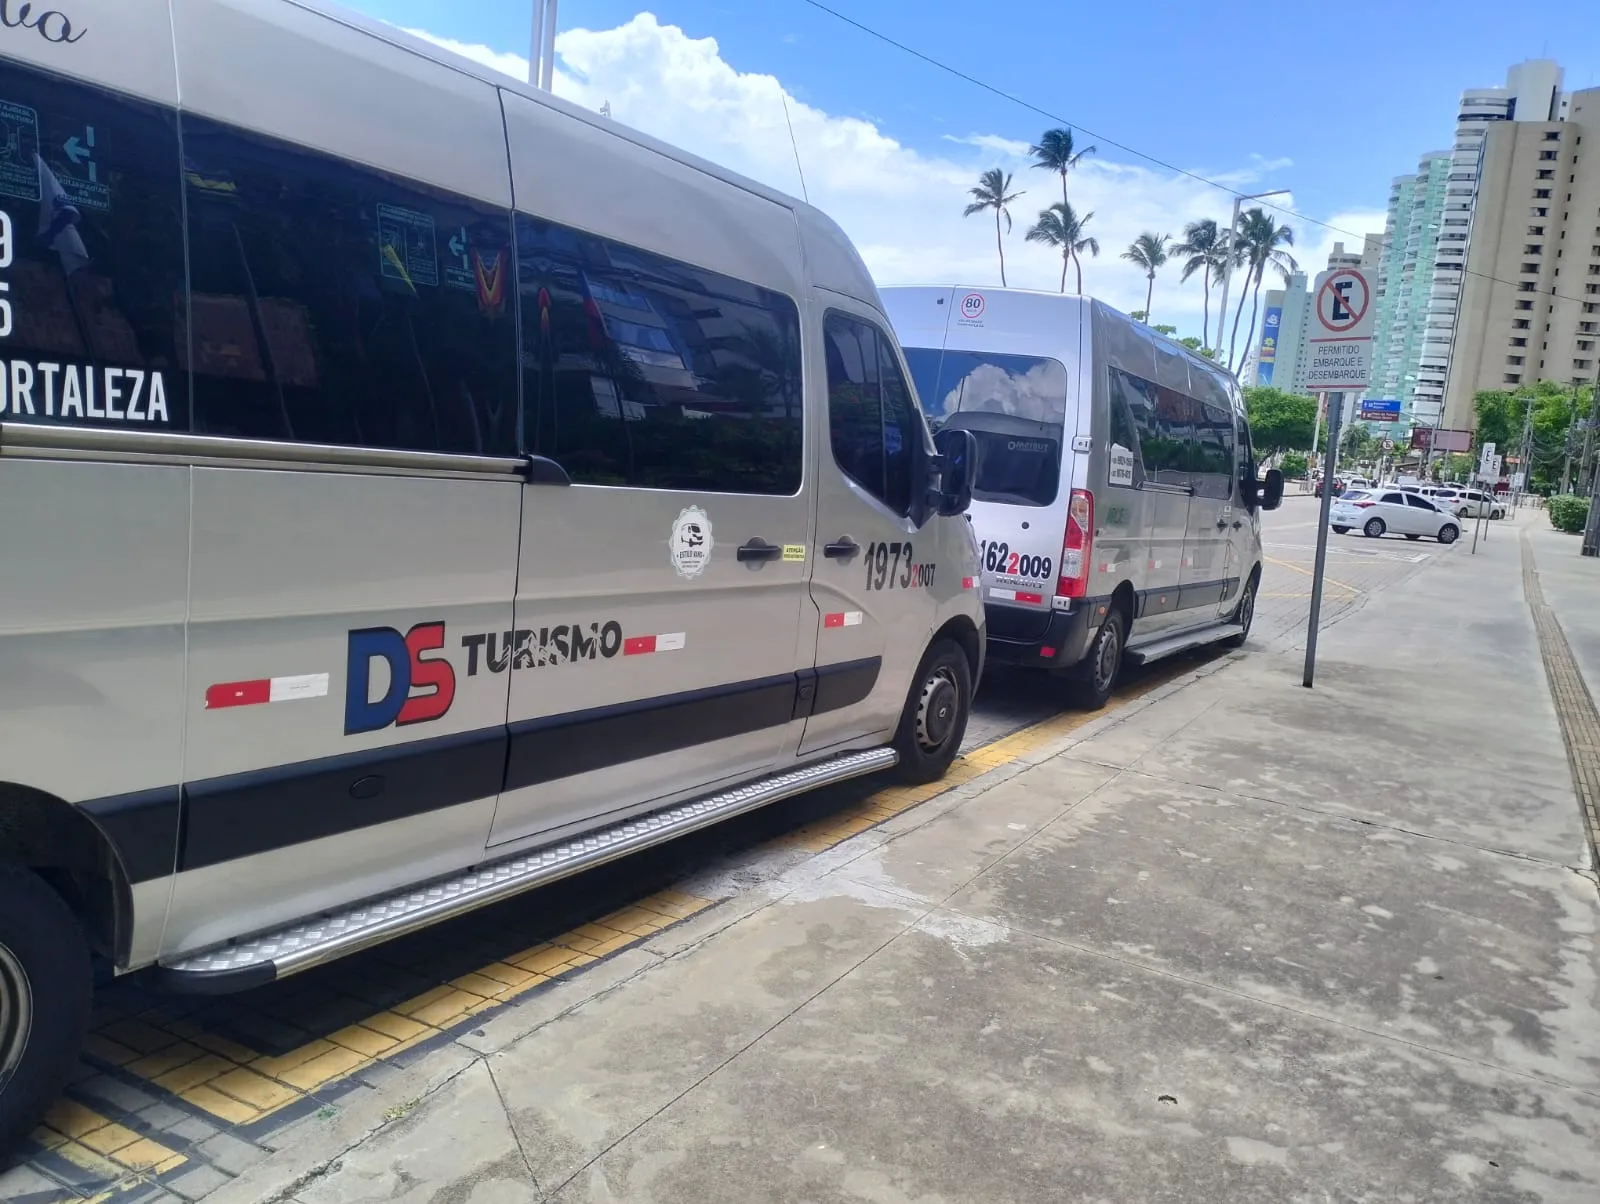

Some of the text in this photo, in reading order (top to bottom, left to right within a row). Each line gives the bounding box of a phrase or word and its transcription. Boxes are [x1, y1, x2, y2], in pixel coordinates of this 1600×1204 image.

[965, 298, 981, 308] 80
[1318, 344, 1360, 355] PERMITIDO
[1313, 357, 1363, 368] EMBARQUE E
[1308, 369, 1367, 380] DESEMBARQUE
[0, 359, 169, 422] RTALEZA
[344, 620, 623, 736] DS TURISMO
